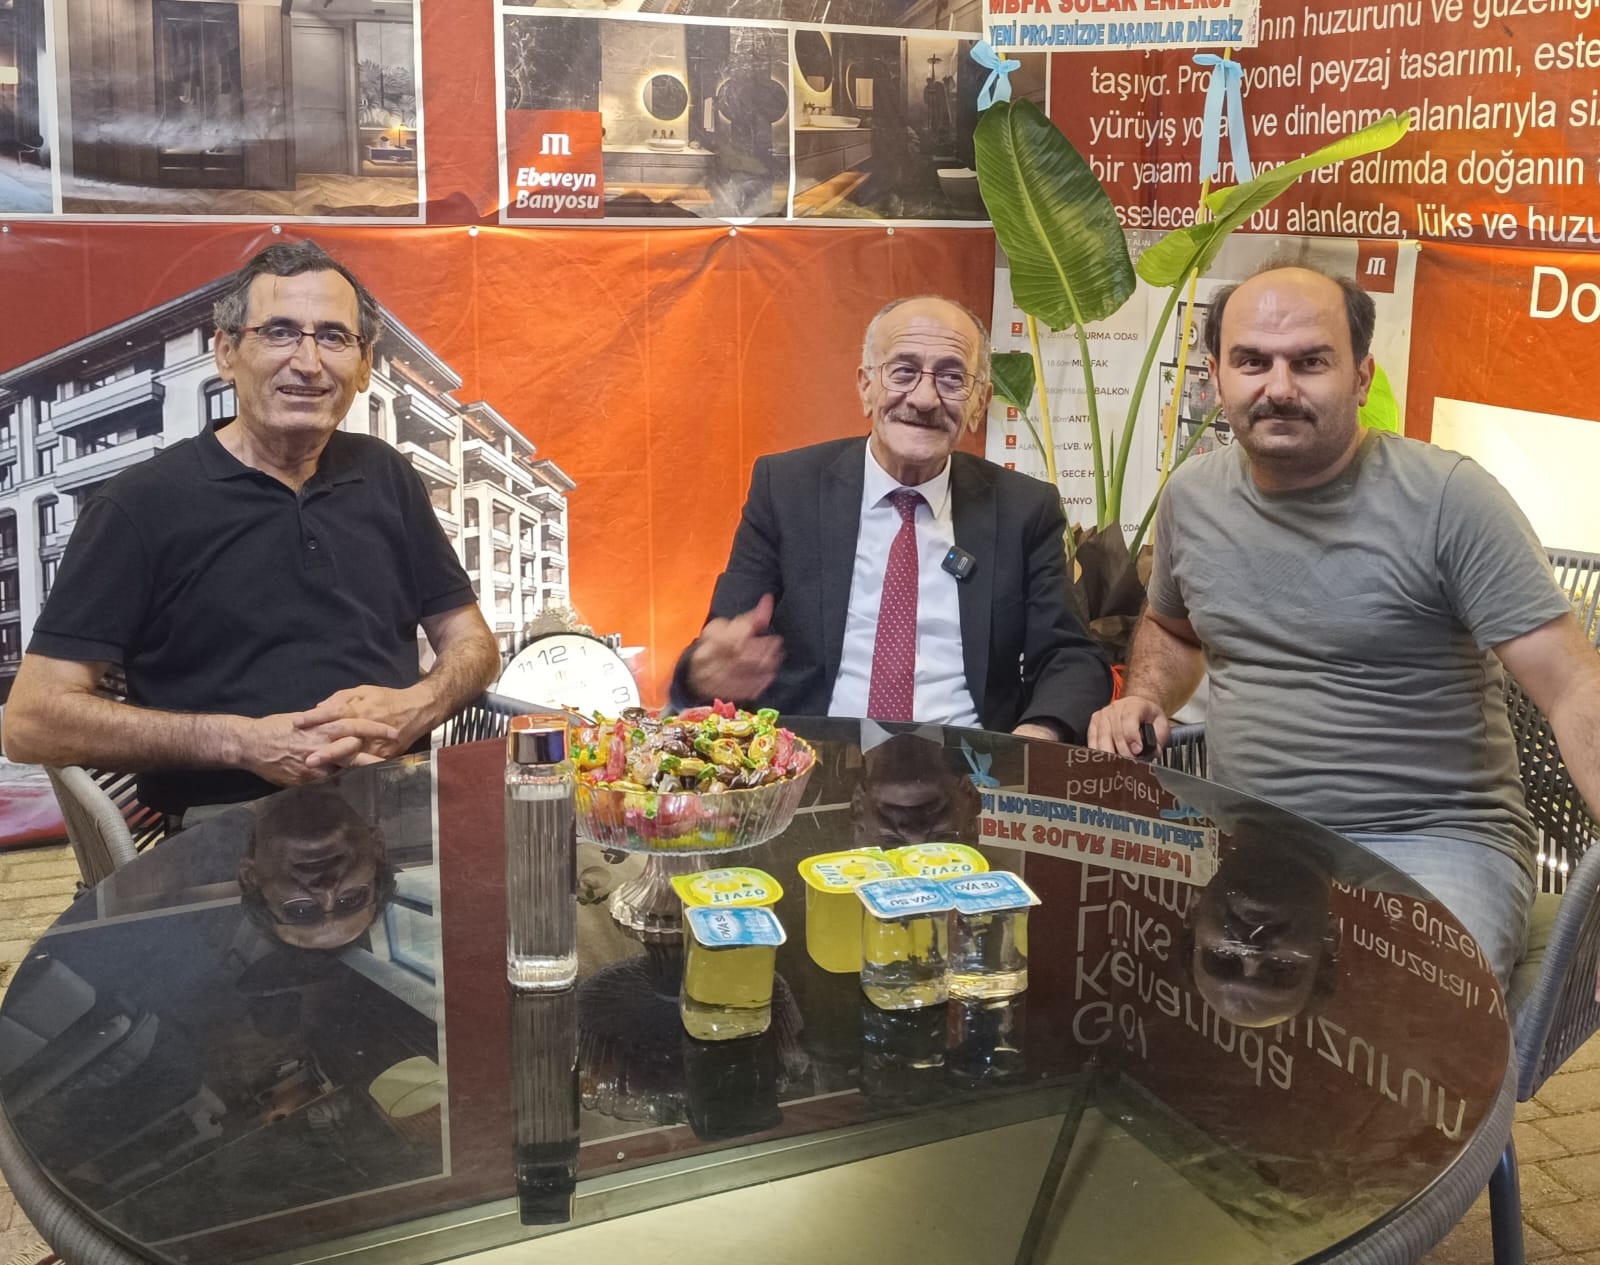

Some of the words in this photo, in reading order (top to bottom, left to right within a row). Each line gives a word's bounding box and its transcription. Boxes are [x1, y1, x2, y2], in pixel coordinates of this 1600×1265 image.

[989, 20, 1017, 46] YENİ
[1020, 18, 1105, 46] PROJENİZDE
[1108, 21, 1184, 48] BAŞARILAR
[1187, 13, 1243, 43] DİLERİZ
[1303, 1, 1421, 37] huzurunu
[1431, 0, 1463, 23] ve
[1178, 56, 1302, 96] Proyonel
[1310, 48, 1391, 93] peyzaj
[1400, 46, 1521, 79] tasarımı,
[1252, 112, 1278, 137] ve
[1406, 91, 1557, 138] alanlarıyla
[1568, 88, 1600, 127] si
[516, 167, 597, 192] Ebeveyn
[1089, 154, 1125, 183] bir
[1350, 151, 1447, 185] adımda
[1458, 149, 1585, 194] doğanın
[515, 189, 600, 214] Banyosu
[1250, 207, 1279, 231] bu
[1287, 201, 1408, 240] alanlarda,
[1417, 203, 1473, 238] lüks
[1482, 212, 1518, 240] ve
[1529, 265, 1600, 323] Do
[1094, 386, 1130, 396] BALKON
[1062, 469, 1086, 478] GECE
[1058, 496, 1093, 505] BANYO
[537, 645, 568, 666] 12
[579, 646, 587, 656] 1
[518, 660, 534, 673] 11
[612, 686, 630, 704] 3
[953, 881, 980, 891] OVA
[981, 880, 1000, 889] SU
